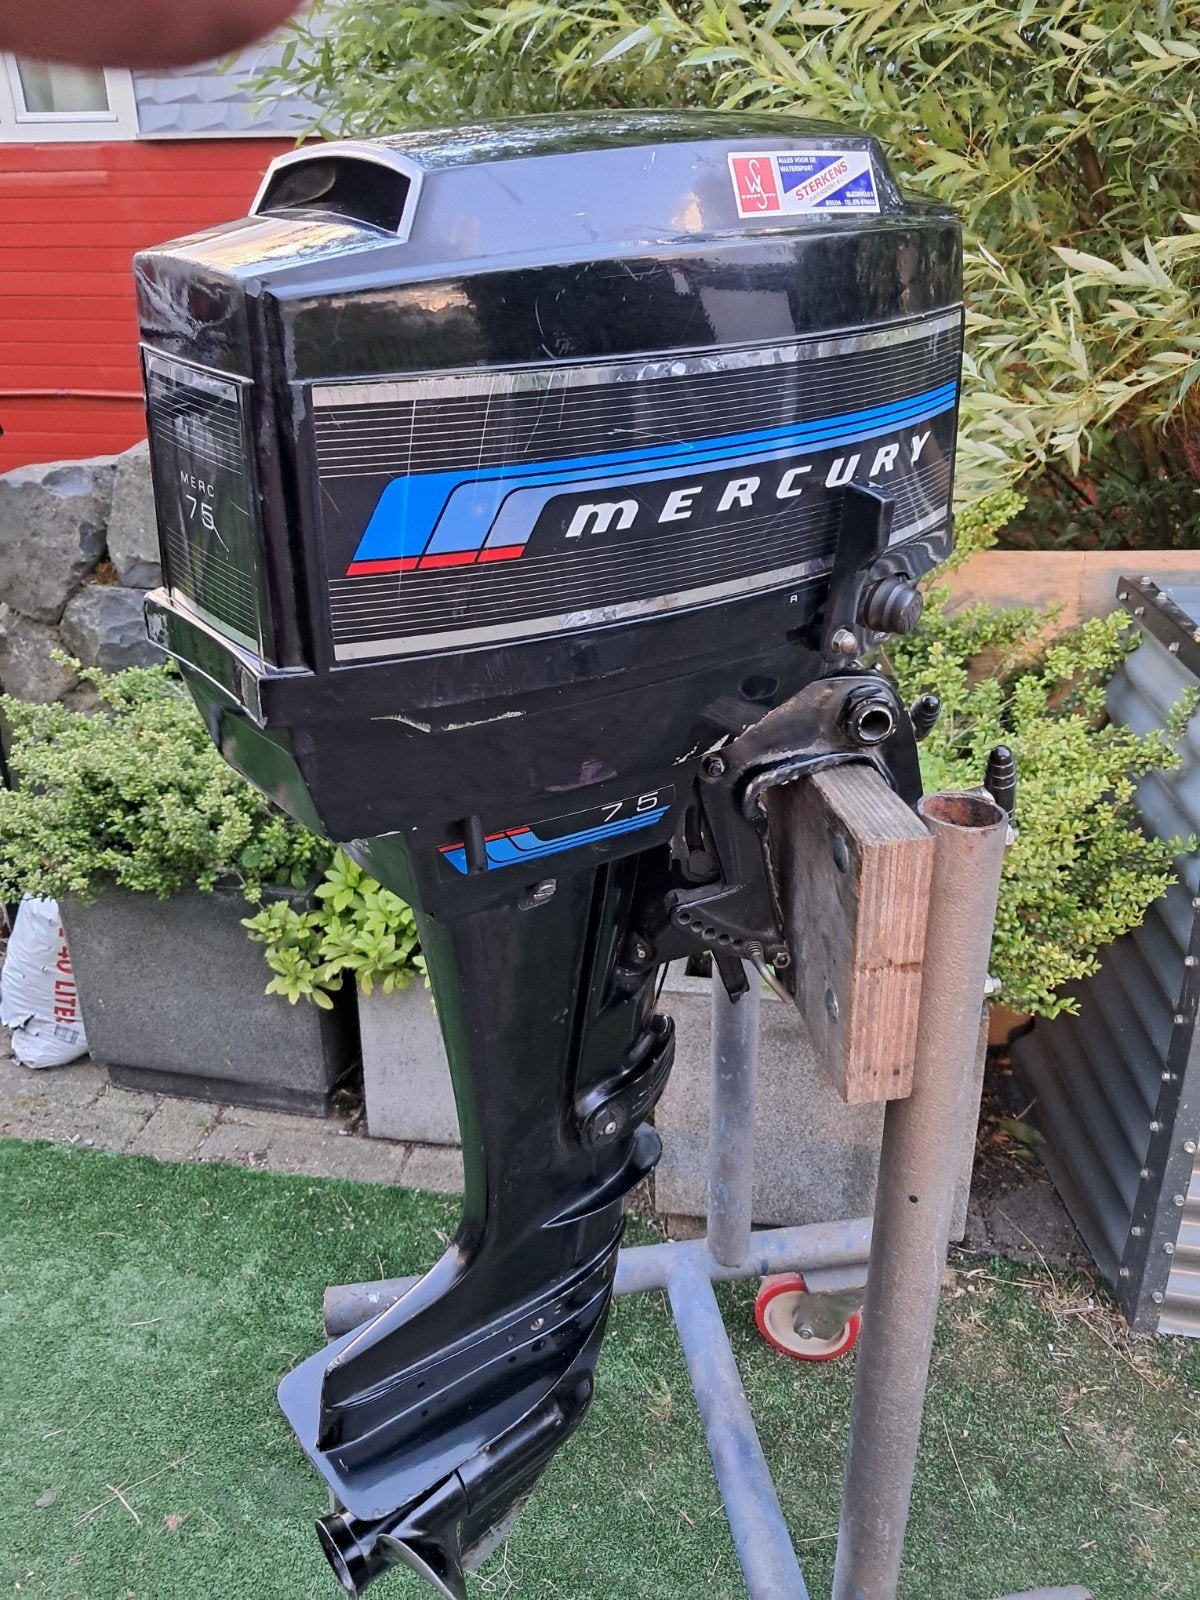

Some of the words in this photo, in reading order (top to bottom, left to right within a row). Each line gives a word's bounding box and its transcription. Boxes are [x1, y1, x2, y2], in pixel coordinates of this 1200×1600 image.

[795, 161, 848, 201] STERKENS
[180, 470, 215, 498] MERC
[565, 431, 931, 538] MERCURY
[186, 494, 214, 530] 75
[601, 790, 659, 823] 75
